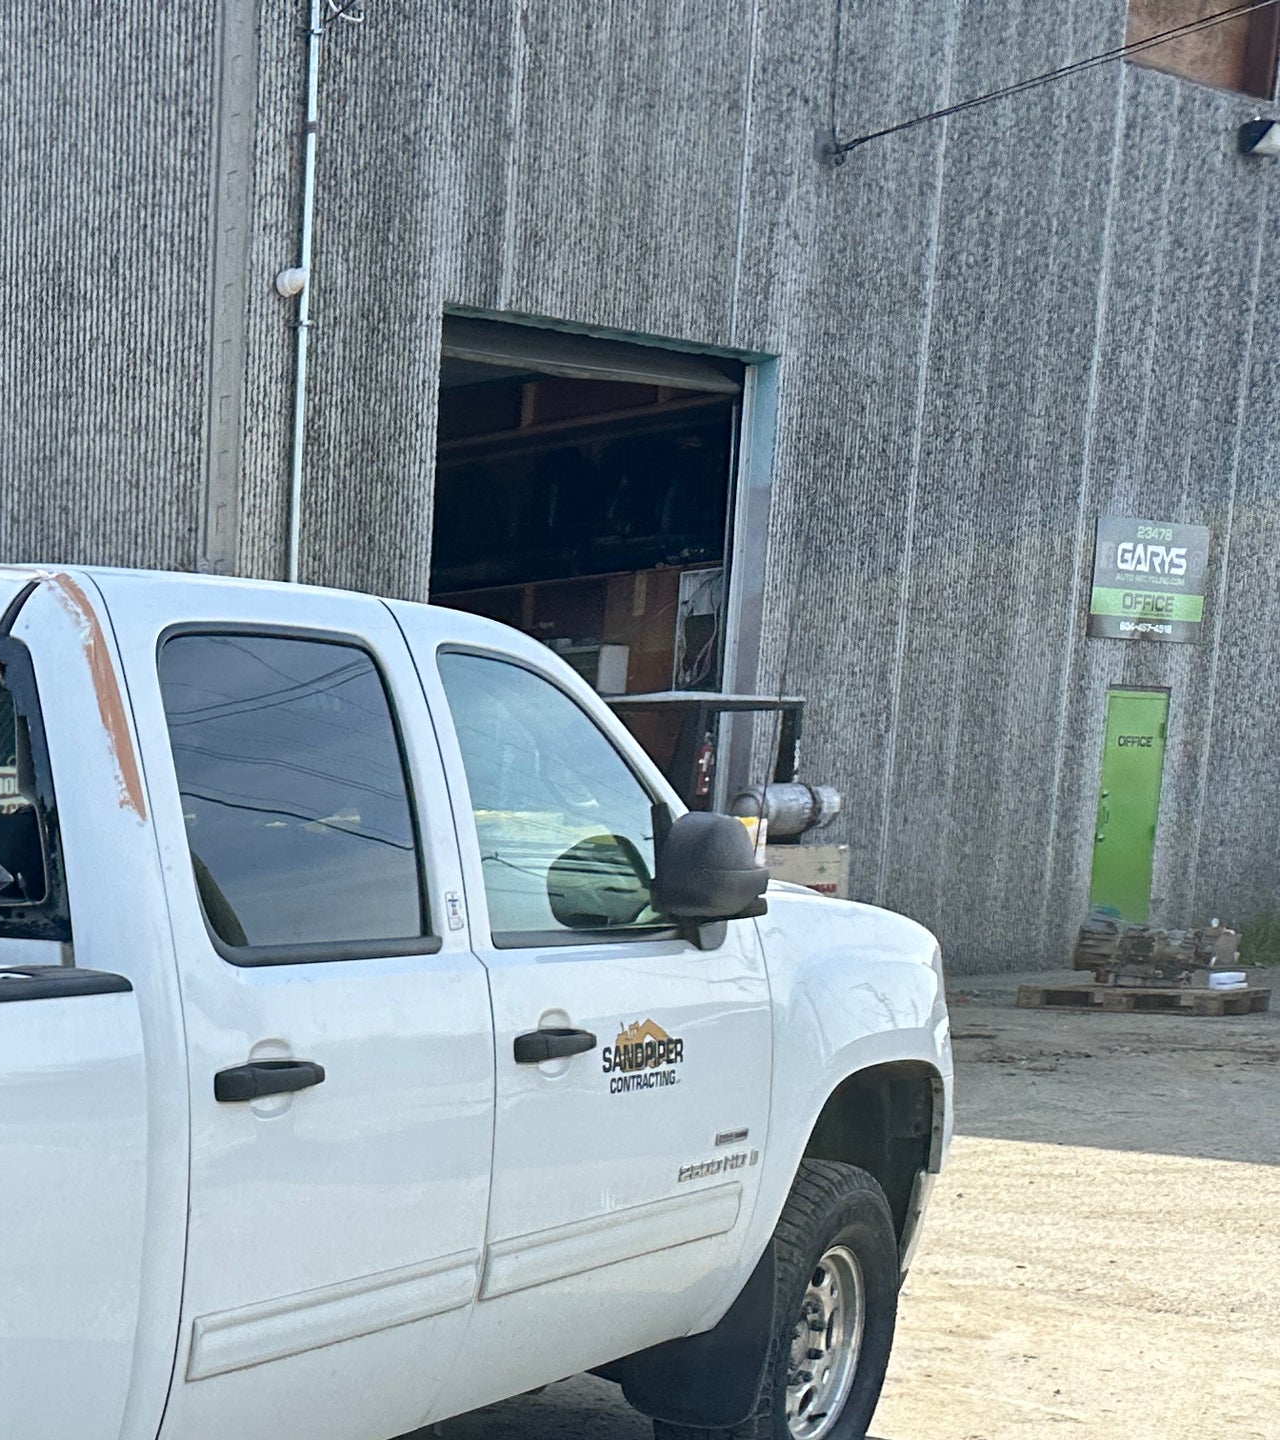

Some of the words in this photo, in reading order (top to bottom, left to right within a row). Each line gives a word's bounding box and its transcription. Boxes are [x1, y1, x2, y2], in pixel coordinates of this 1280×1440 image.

[1116, 541, 1187, 576] GARYS
[1122, 592, 1175, 613] OFFICE
[1117, 735, 1153, 748] OFFICE
[610, 1070, 676, 1094] CONTRACTING
